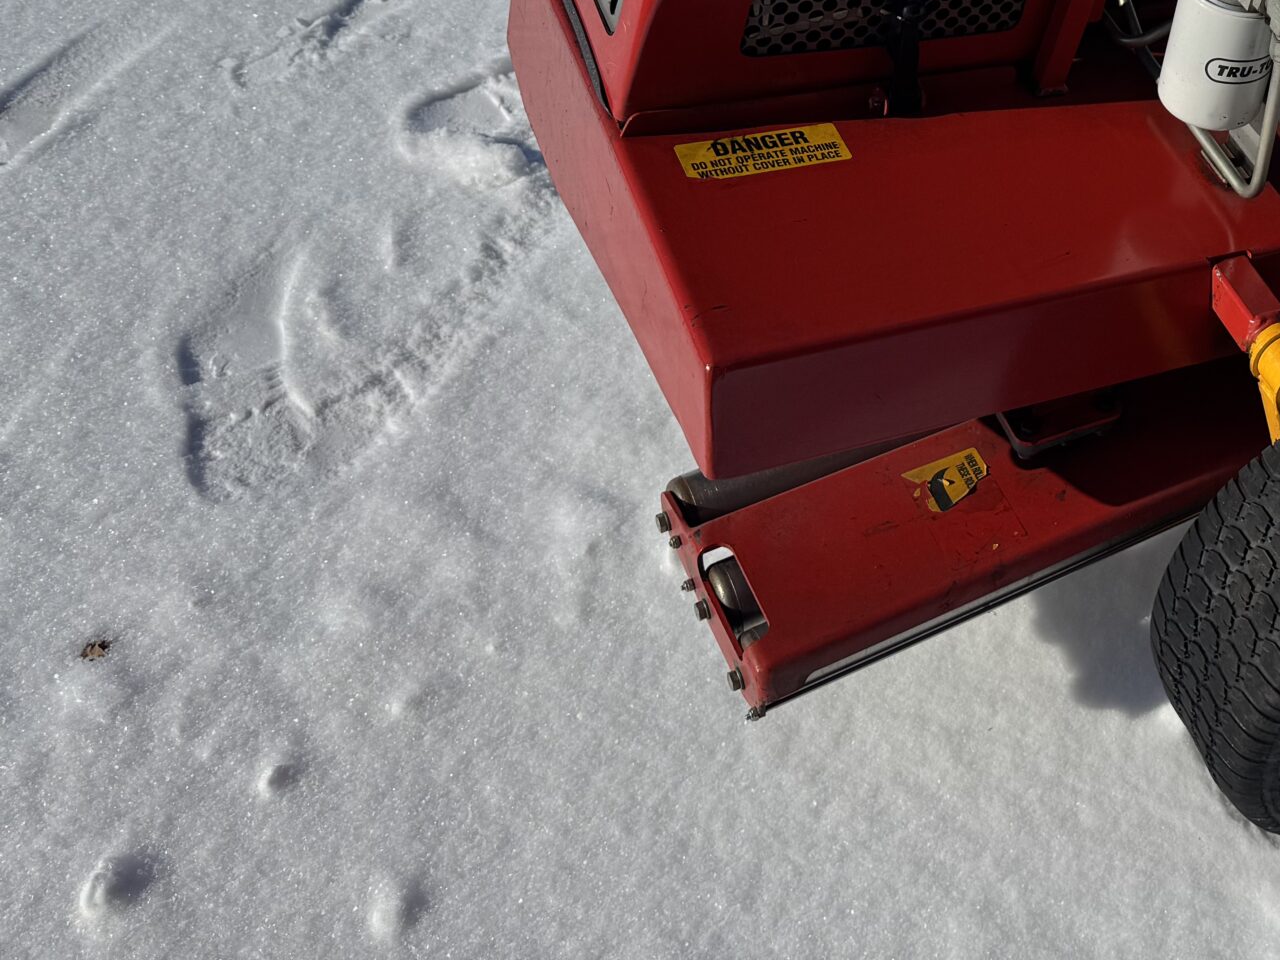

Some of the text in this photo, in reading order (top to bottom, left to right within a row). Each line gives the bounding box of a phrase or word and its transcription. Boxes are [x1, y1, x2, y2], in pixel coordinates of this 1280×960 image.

[1217, 60, 1272, 78] TRU-TU
[691, 141, 840, 172] DO NOT OPERATE MACHINE
[711, 130, 810, 157] DANGER
[697, 150, 843, 179] WITHOUT COVER IN PLACE
